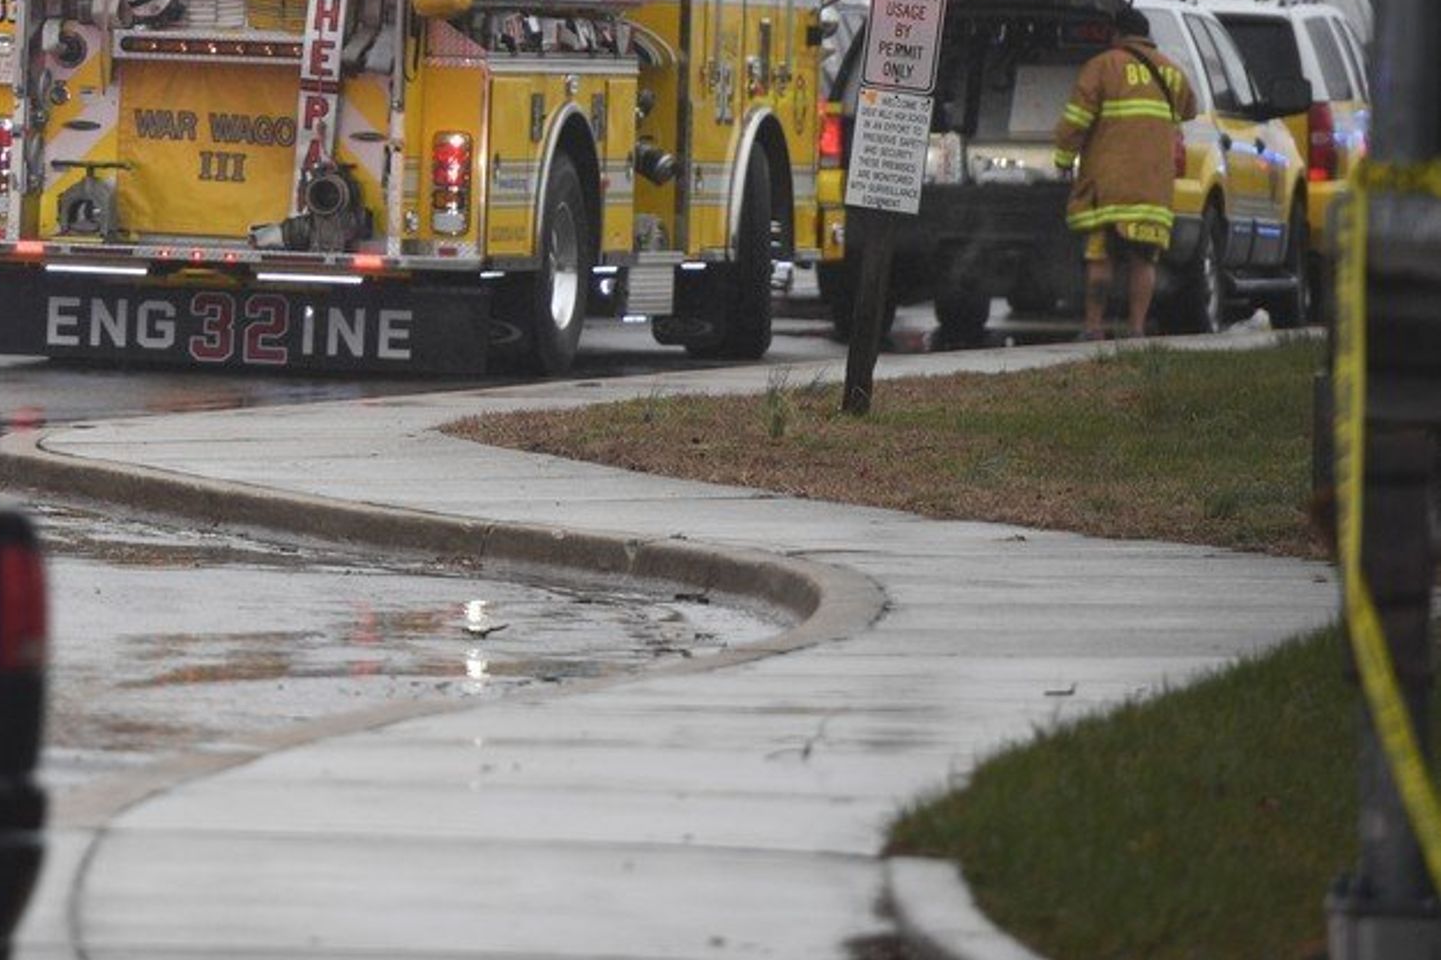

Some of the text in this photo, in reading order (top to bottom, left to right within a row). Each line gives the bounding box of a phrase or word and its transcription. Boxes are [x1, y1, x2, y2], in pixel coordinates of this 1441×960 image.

[886, 3, 927, 21] USAGE
[894, 23, 912, 38] BY
[878, 42, 924, 61] PERMIT
[882, 61, 915, 78] ONLY
[134, 108, 198, 141] WAR
[198, 150, 247, 182] III
